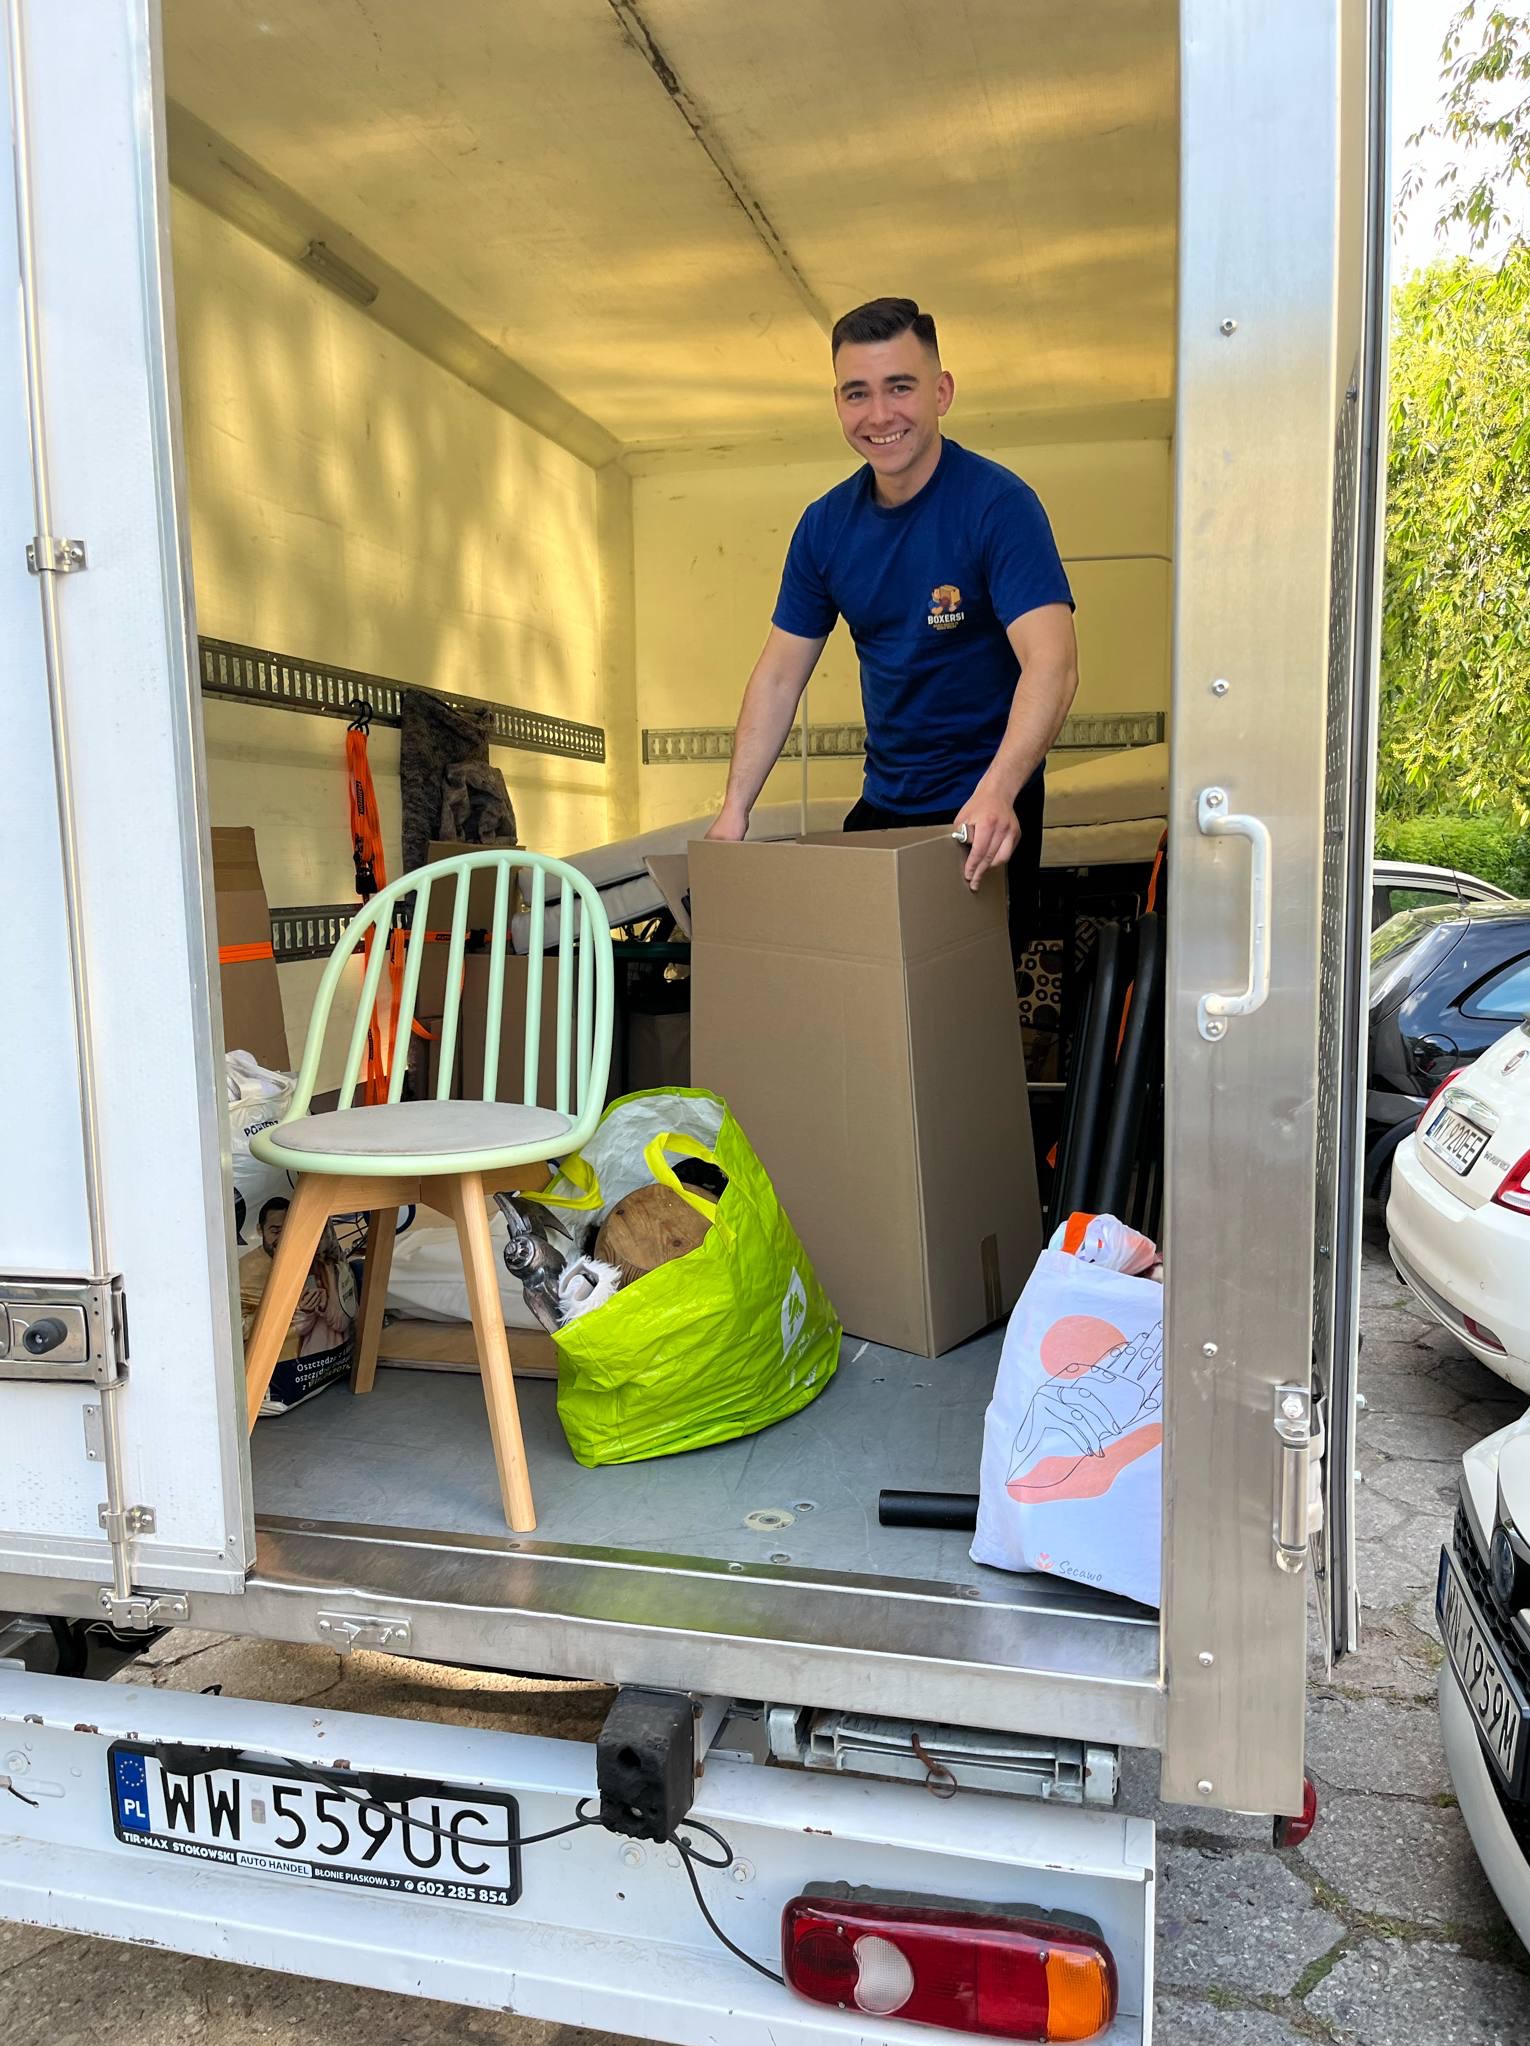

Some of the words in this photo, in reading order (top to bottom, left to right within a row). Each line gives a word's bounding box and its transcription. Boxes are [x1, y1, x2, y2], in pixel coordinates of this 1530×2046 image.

[928, 611, 965, 625] BOXERSI
[1059, 1560, 1103, 1581] Secawo
[1463, 1625, 1517, 1771] 1959M
[123, 1798, 146, 1818] PL
[159, 1766, 241, 1841] WW
[272, 1784, 491, 1875] 559UC
[122, 1831, 169, 1850] TIR-MAX
[172, 1841, 235, 1863] STOKOWSKI
[240, 1856, 267, 1868] AUTO
[268, 1861, 309, 1875] HANDEL
[314, 1867, 345, 1881] BŁONIE
[345, 1873, 389, 1887] PIASKOWA
[389, 1878, 401, 1889] 37
[416, 1880, 445, 1896] 602
[447, 1884, 476, 1900] 285
[479, 1888, 508, 1904] 854
